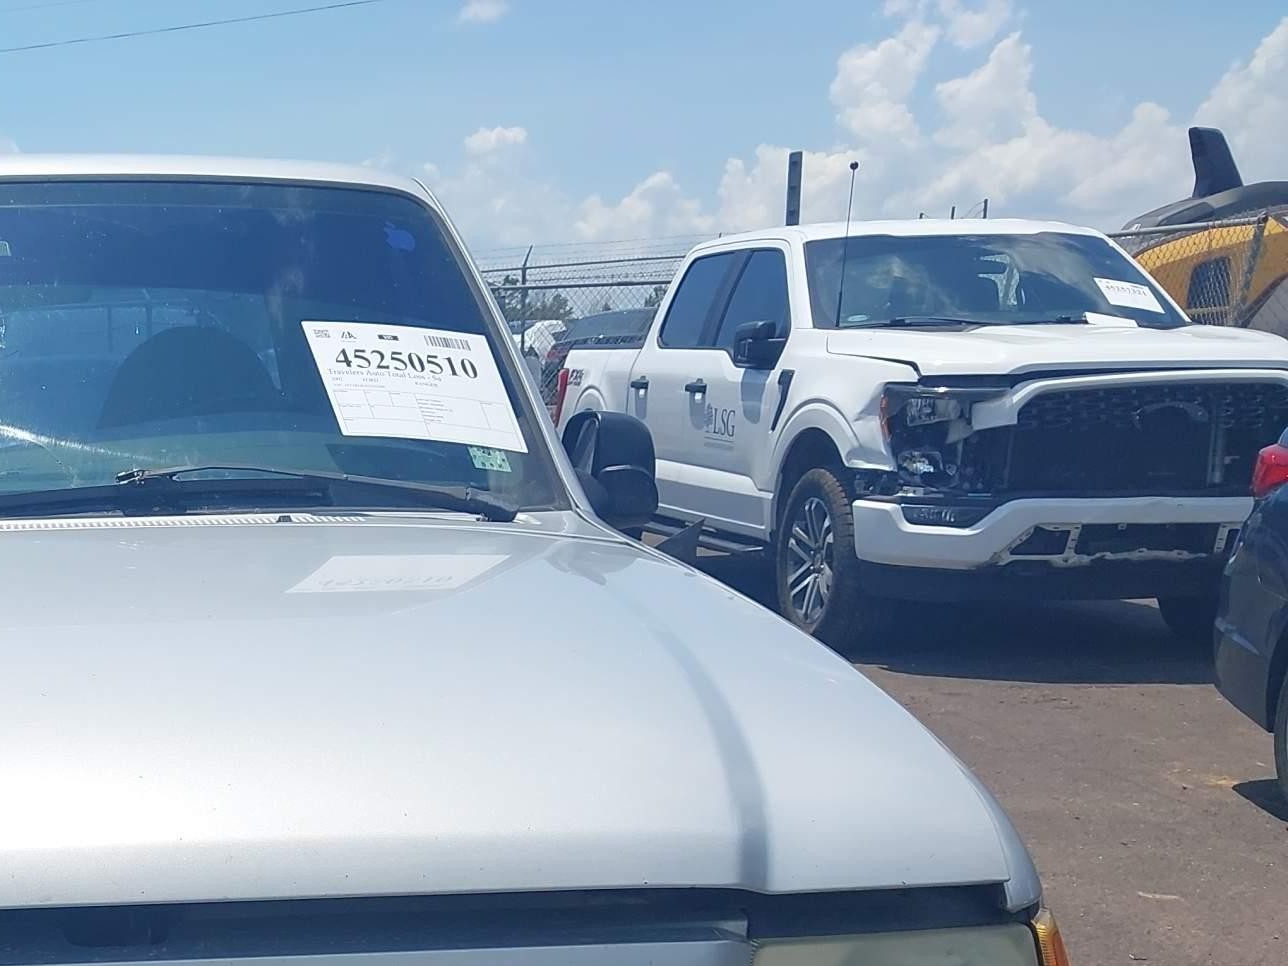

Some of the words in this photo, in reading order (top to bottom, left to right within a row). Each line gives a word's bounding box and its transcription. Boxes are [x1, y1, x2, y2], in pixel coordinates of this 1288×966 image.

[328, 367, 364, 376] Travelers
[386, 370, 407, 378] Total
[335, 348, 478, 379] 45250510
[713, 407, 736, 438] LSG
